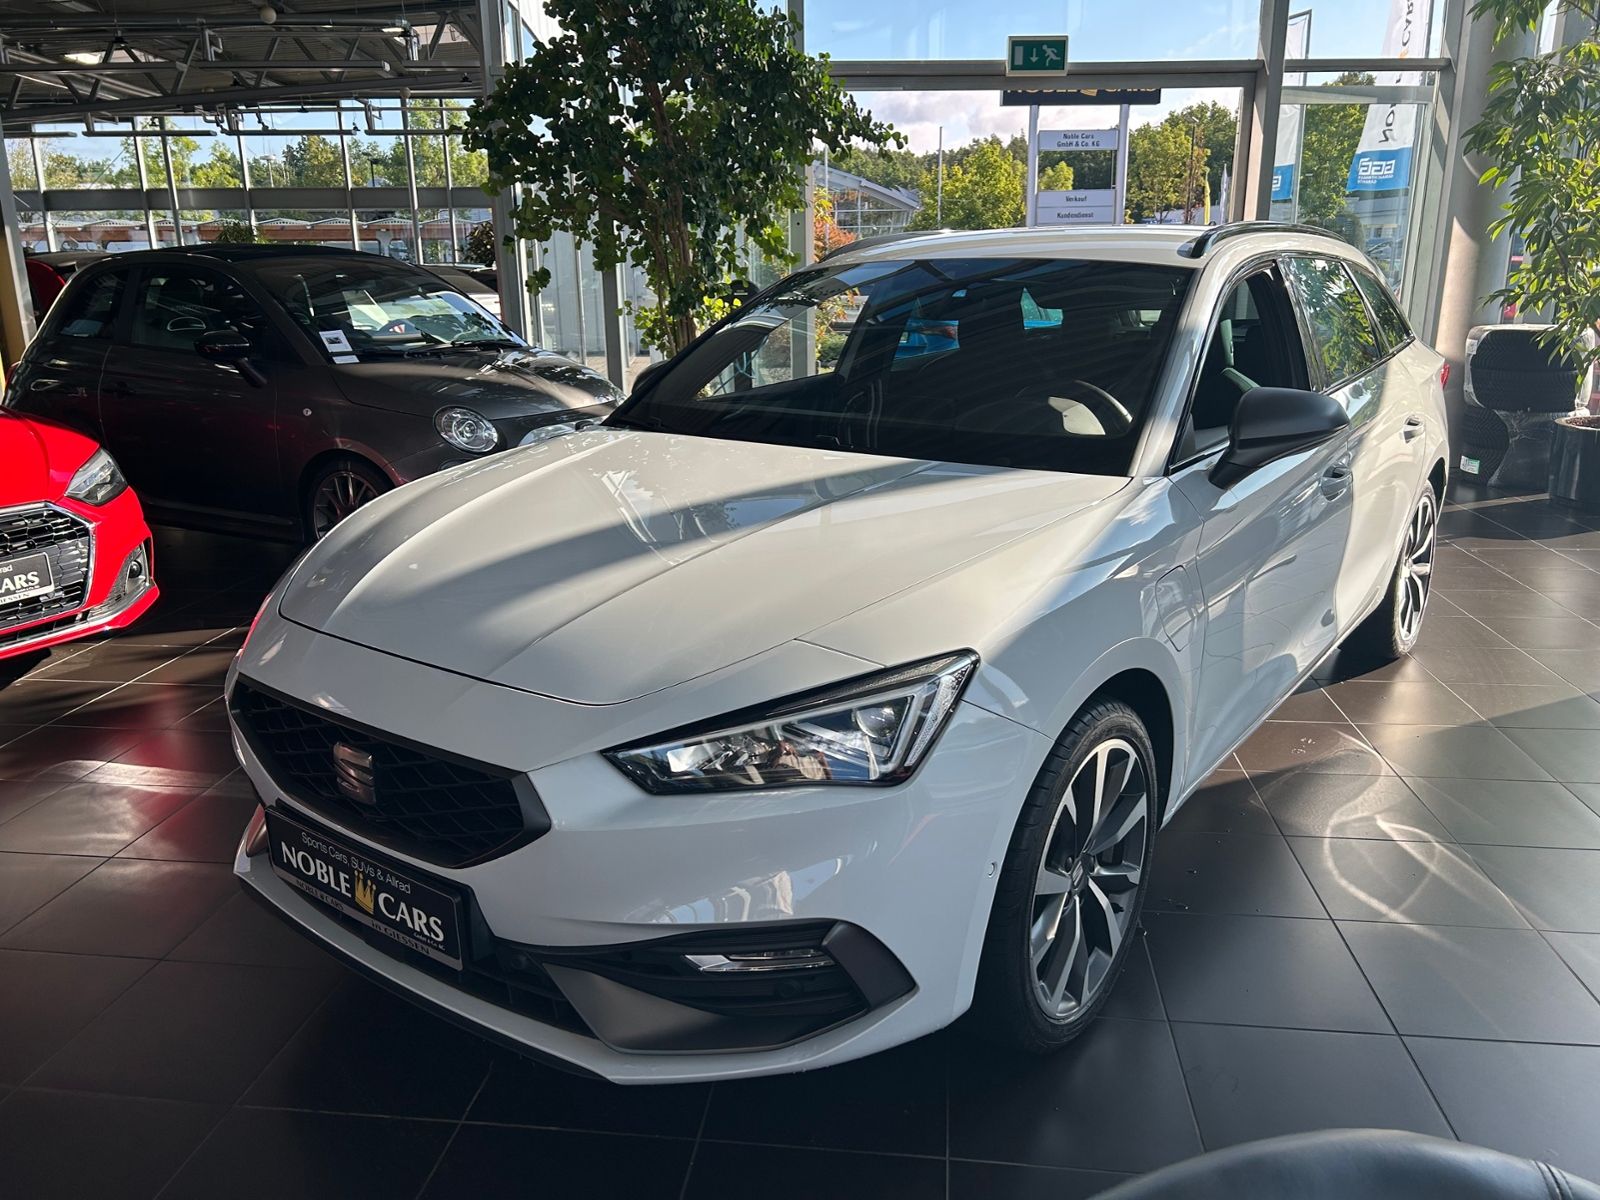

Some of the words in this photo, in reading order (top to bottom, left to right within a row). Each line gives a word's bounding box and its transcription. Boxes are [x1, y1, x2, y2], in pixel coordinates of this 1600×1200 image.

[0, 571, 40, 594] ARS
[280, 841, 352, 898] NOBLE
[378, 892, 445, 943] CARS
[301, 832, 328, 854] Sports
[351, 856, 375, 877] SUVs
[376, 869, 385, 881] &
[385, 873, 412, 895] Allrad
